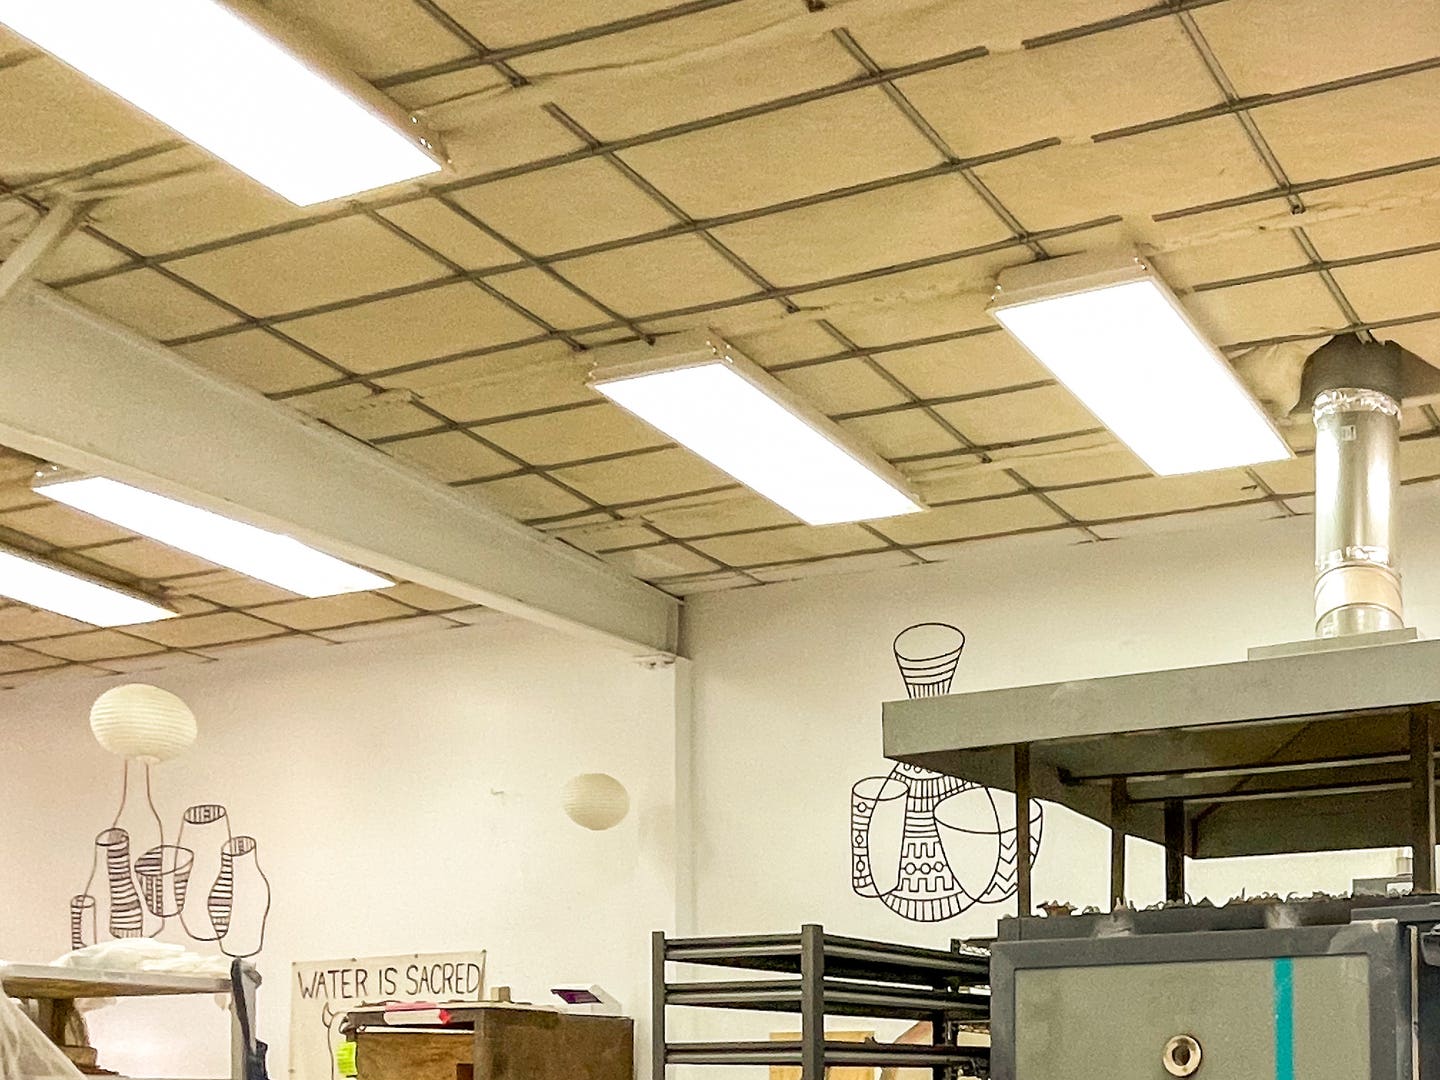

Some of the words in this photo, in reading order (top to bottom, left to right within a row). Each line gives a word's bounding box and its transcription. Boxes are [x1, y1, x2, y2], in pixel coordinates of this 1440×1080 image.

[298, 969, 368, 999] WATER
[379, 967, 398, 996] IS
[405, 963, 480, 995] SACRED
